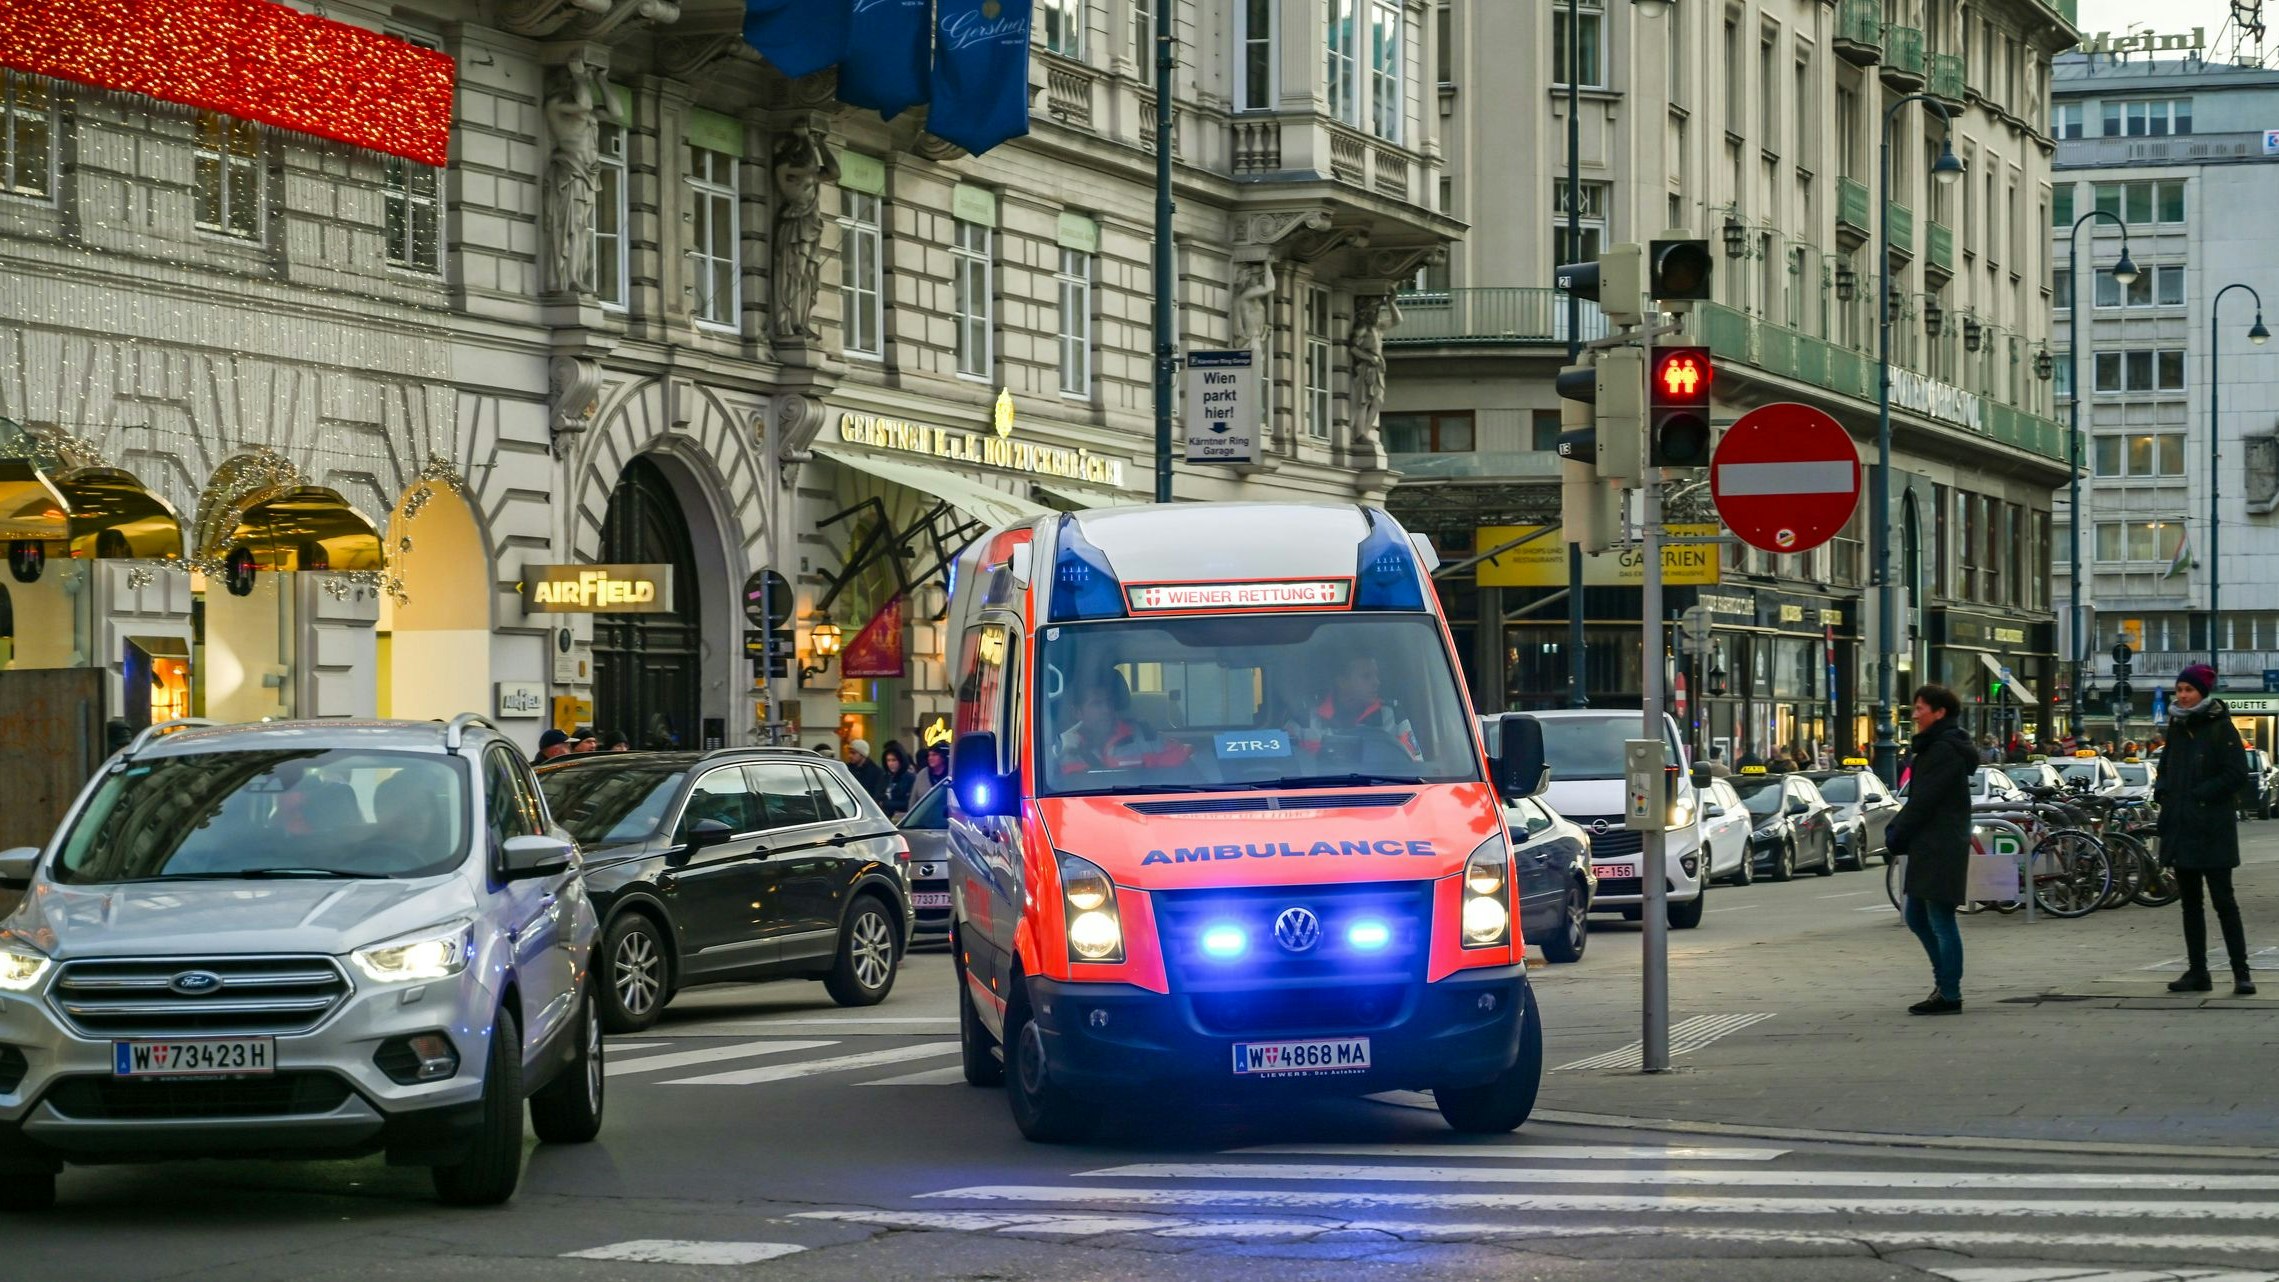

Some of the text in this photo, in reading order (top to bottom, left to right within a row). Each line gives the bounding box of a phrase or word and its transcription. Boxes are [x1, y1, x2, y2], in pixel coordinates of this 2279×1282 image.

[2079, 27, 2206, 53] Meinl
[1560, 277, 1571, 287] 21
[1204, 372, 1236, 384] Wien
[1203, 390, 1237, 404] parkt
[1205, 406, 1234, 418] hier!
[841, 412, 933, 454] GERSTNER
[1189, 436, 1249, 446] Kärntner Ring
[1203, 447, 1235, 456] Garage
[1619, 551, 1705, 567] GARIEN
[1168, 588, 1315, 603] WIENER RETTUNG
[1226, 739, 1280, 752] ZTR-3
[1141, 840, 1436, 866] AMBULANCE
[917, 894, 938, 905] 7337
[181, 976, 209, 986] Ford
[134, 1046, 150, 1069] W
[171, 1044, 245, 1069] 73423
[252, 1043, 264, 1066] H
[1250, 1048, 1264, 1068] W
[1281, 1044, 1332, 1067] 4868
[1337, 1043, 1365, 1064] MA
